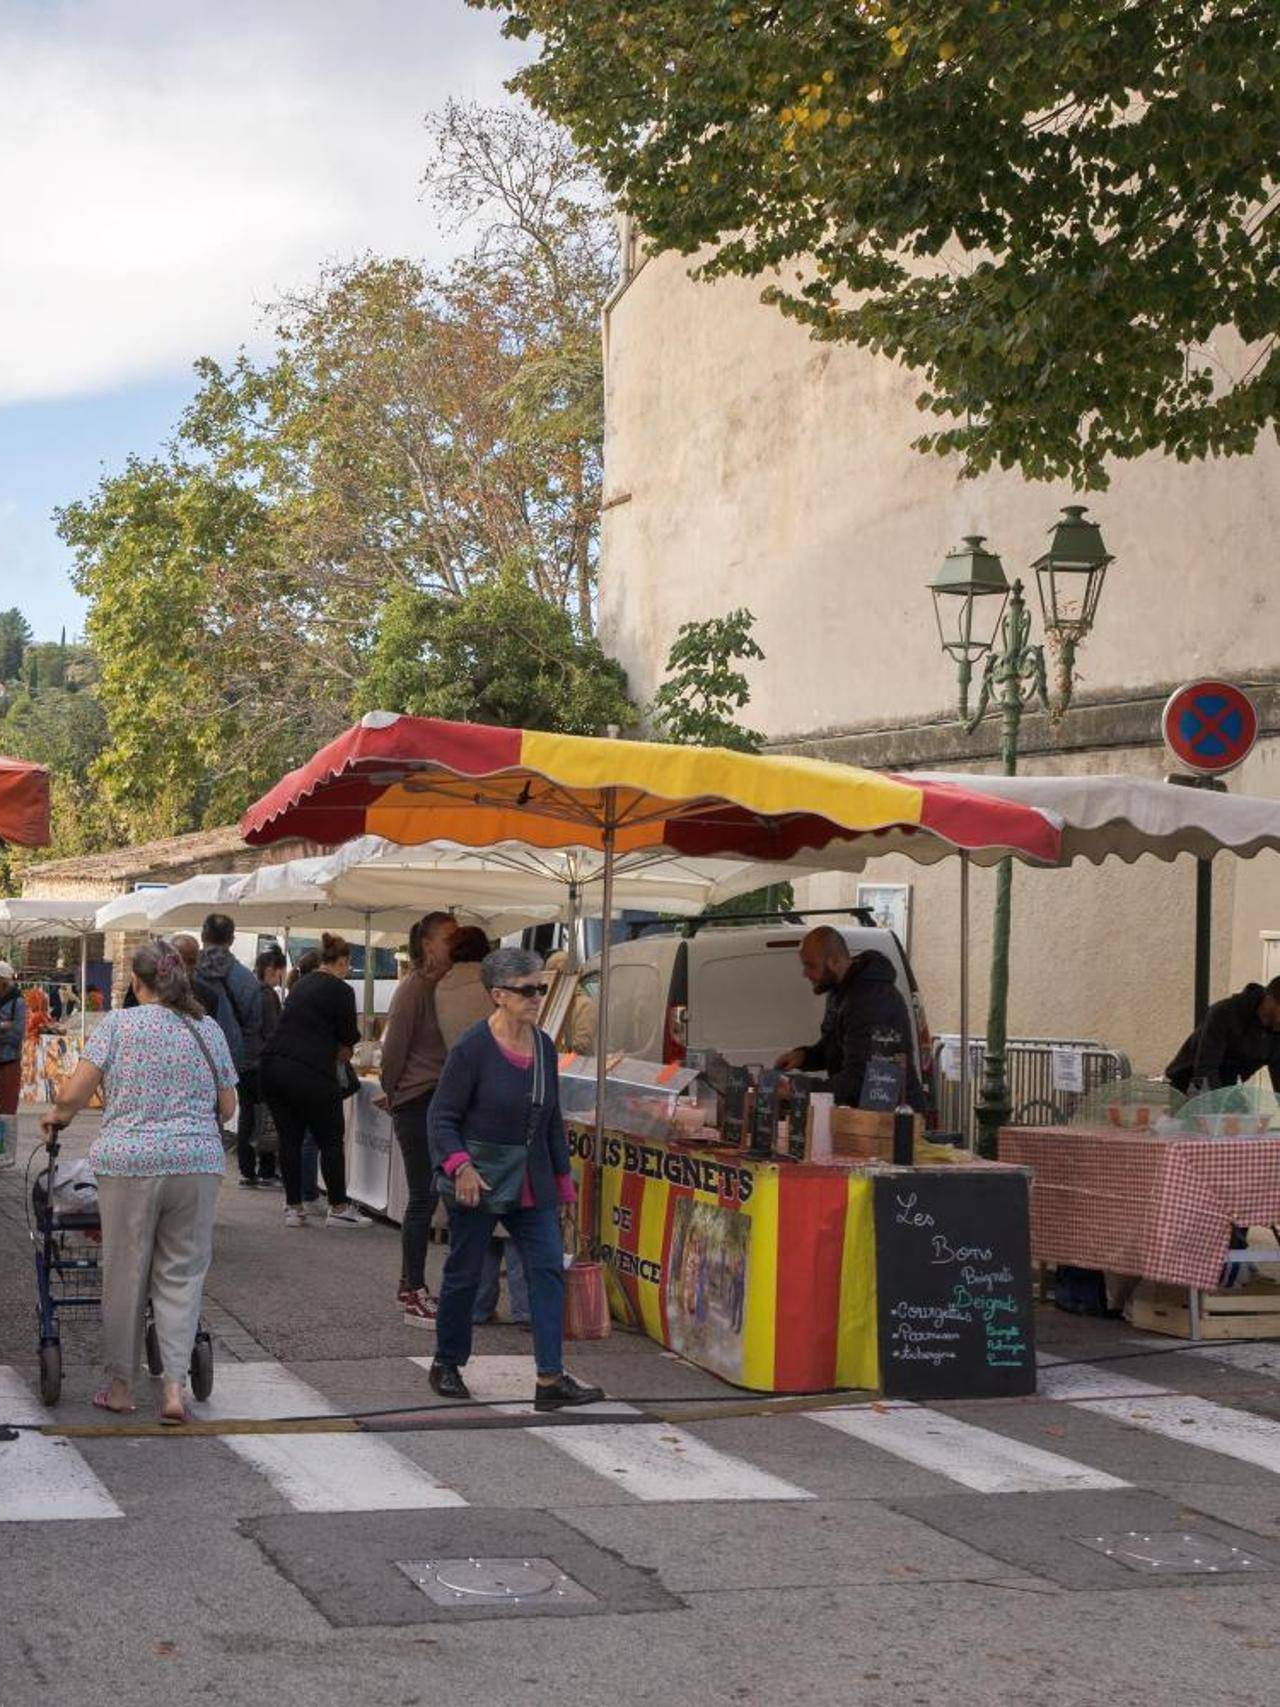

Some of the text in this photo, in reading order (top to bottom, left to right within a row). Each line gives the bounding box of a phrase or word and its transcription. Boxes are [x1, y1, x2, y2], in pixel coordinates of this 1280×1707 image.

[623, 1141, 754, 1203] BEIGNETS
[613, 1206, 632, 1230] DE
[896, 1192, 935, 1227] Les
[931, 1235, 993, 1264] Bons
